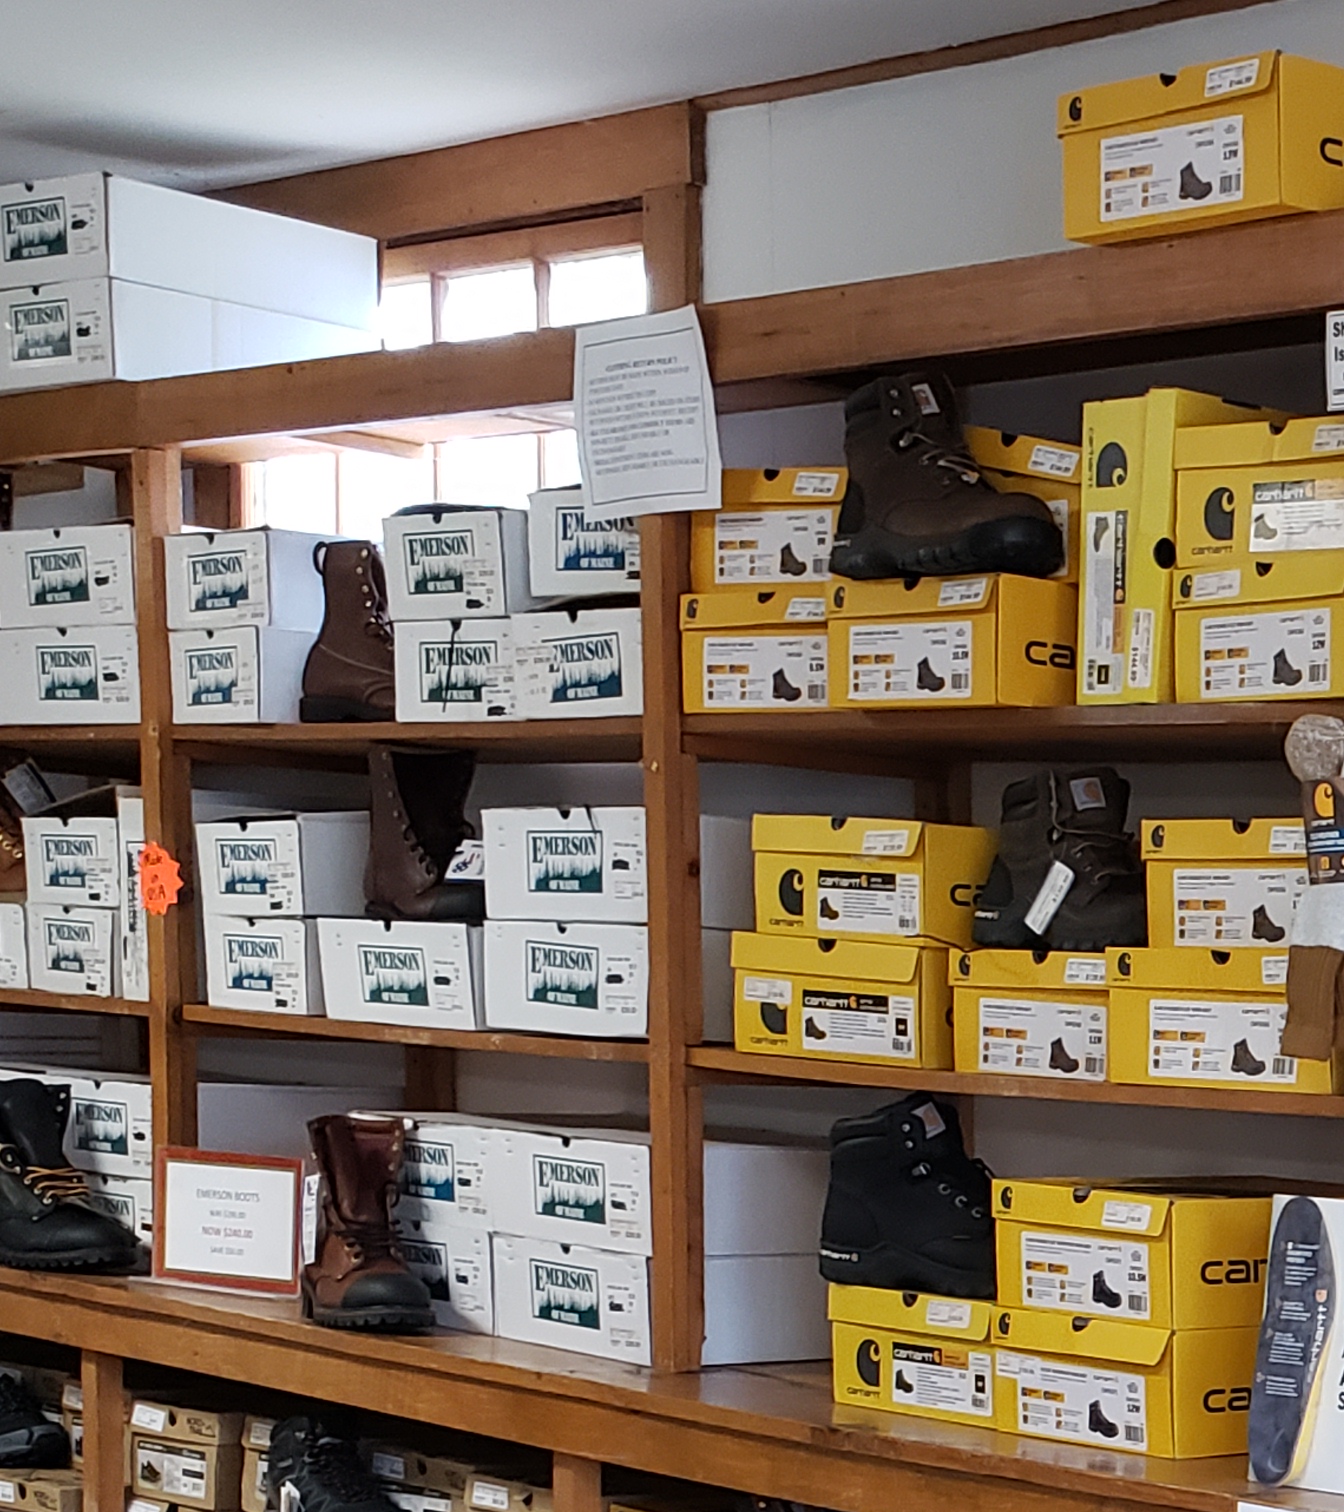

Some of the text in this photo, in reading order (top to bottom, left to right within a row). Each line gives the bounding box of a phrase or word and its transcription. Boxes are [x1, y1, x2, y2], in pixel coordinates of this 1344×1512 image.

[6, 203, 60, 235] EMERSON
[1334, 347, 1344, 361] Is
[408, 535, 469, 566] EMERSON
[30, 552, 82, 580] EMERSON
[425, 645, 491, 674] EMERSON
[46, 839, 93, 861] EMERSON
[220, 844, 273, 868] EMERSON
[532, 836, 596, 863] EMERSON
[531, 947, 593, 973] EMERSON
[538, 1160, 600, 1187] EMERSON
[535, 1264, 593, 1291] EMERSON
